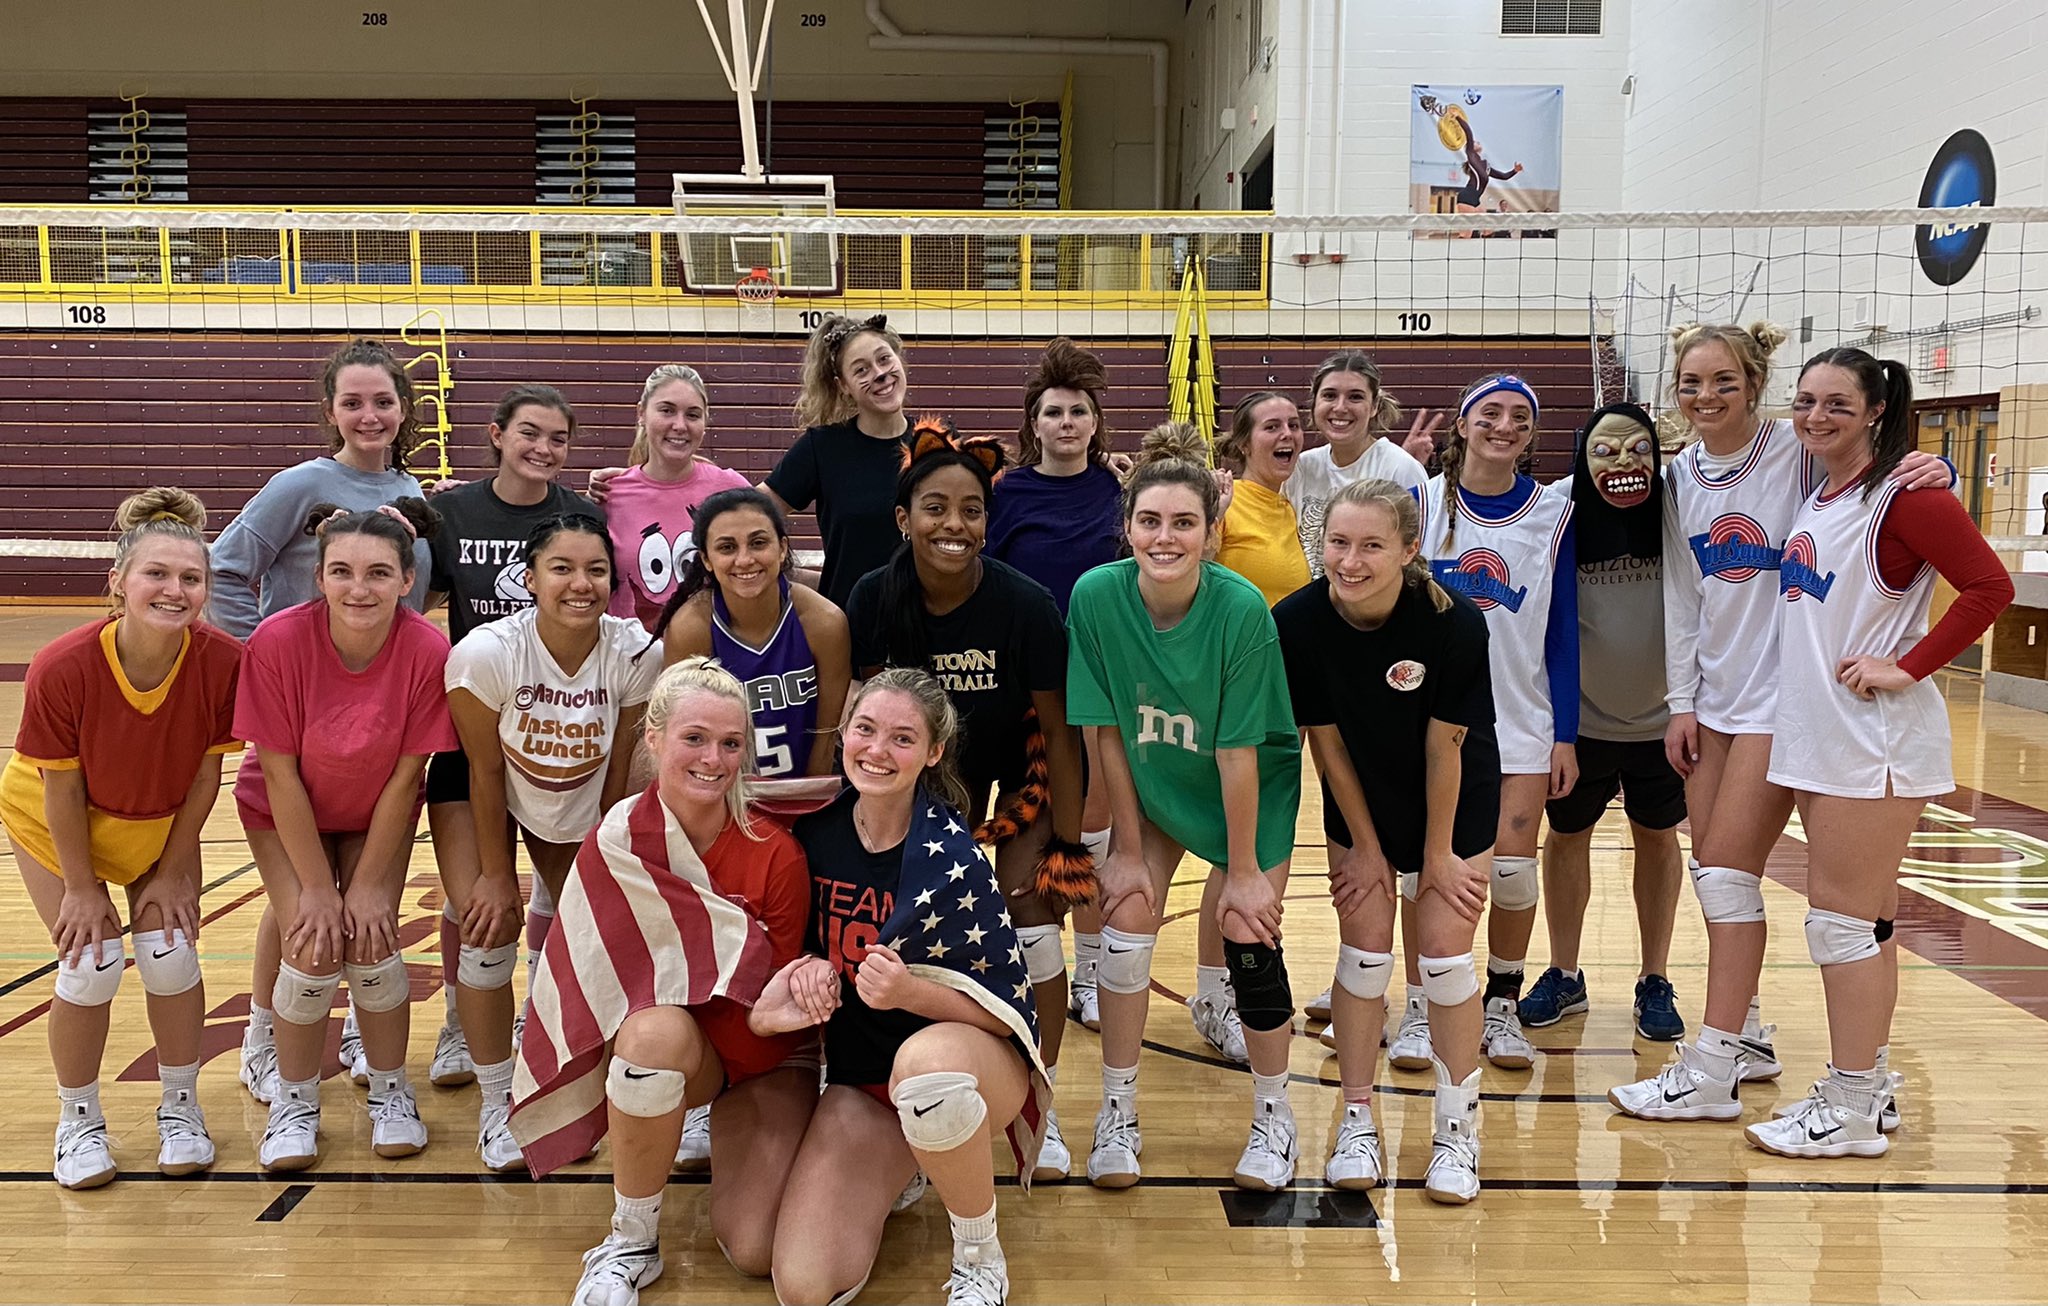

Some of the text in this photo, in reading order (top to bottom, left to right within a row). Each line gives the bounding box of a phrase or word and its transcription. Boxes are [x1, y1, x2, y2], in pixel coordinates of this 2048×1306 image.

[362, 13, 388, 26] 208
[800, 14, 826, 27] 209
[68, 306, 106, 324] 108
[1398, 313, 1431, 331] 110
[1262, 355, 1269, 364] L
[1268, 375, 1275, 383] K
[932, 649, 996, 671] TOWN
[740, 665, 818, 713] AC
[936, 673, 998, 691] YBALL
[534, 683, 608, 709] Maruchn
[517, 712, 606, 740] Instant
[1137, 705, 1198, 753] m
[522, 734, 602, 759] Lunch
[754, 724, 793, 777] 5
